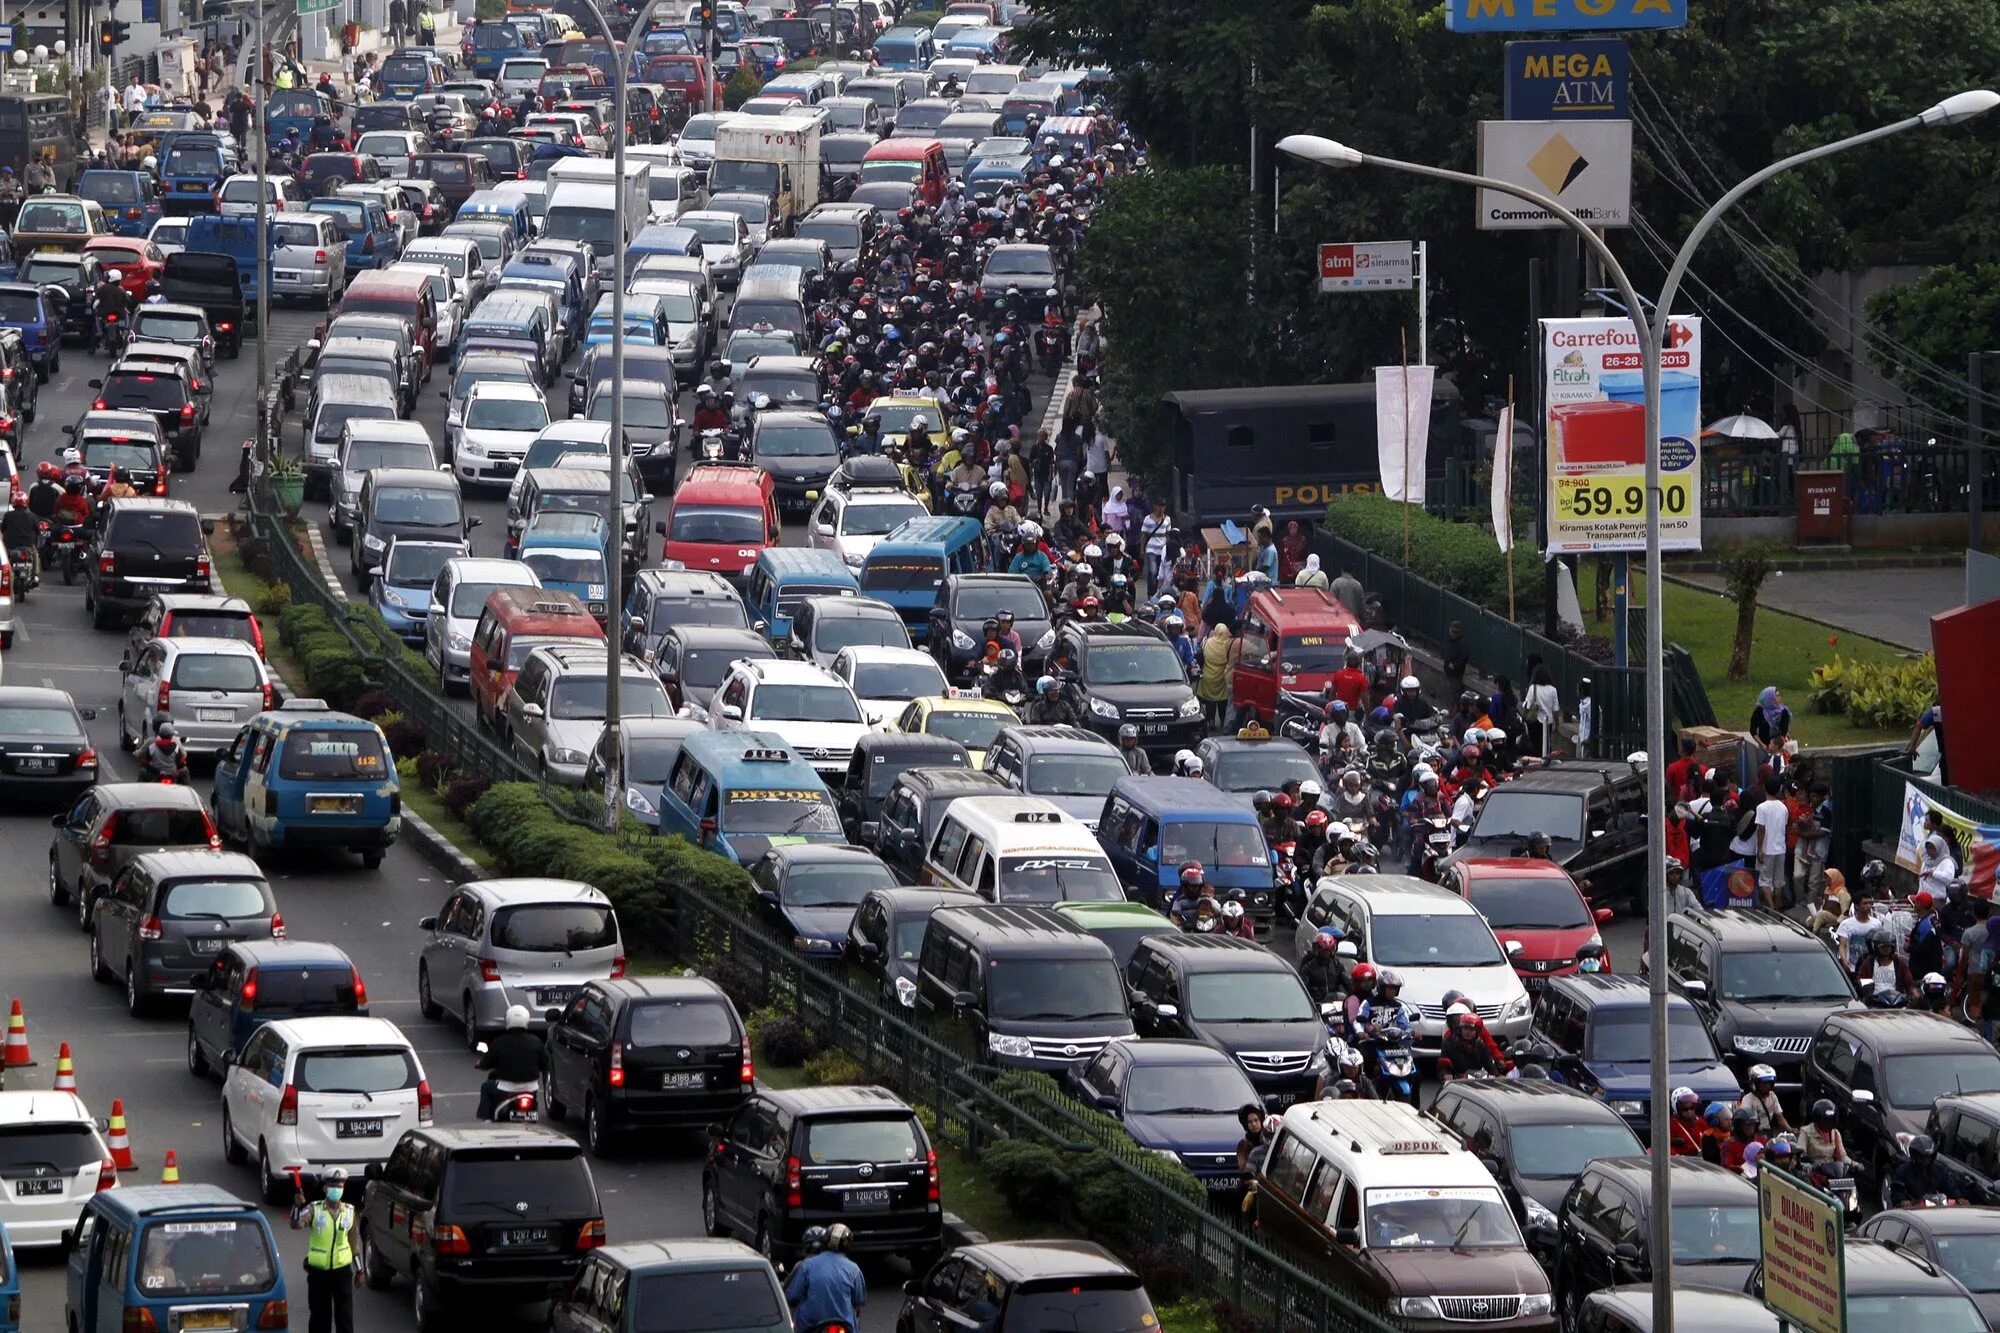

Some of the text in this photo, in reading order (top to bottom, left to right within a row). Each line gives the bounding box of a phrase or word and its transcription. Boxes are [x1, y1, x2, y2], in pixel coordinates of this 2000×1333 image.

[1524, 53, 1613, 78] MEGA
[1553, 80, 1614, 104] ATM
[1325, 255, 1409, 268] atm sinarmas
[1552, 328, 1639, 347] Carrefou
[1605, 355, 1686, 366] 26-28 2013
[1553, 368, 1590, 382] Fitrah
[1573, 485, 1685, 516] 59.90
[1559, 524, 1593, 532] Kiramas
[1586, 532, 1636, 540] Transparant
[358, 756, 376, 765] 112
[731, 790, 822, 800] DEPOK
[1014, 860, 1102, 872] AXEL
[1729, 898, 1752, 907] Mobil
[664, 1072, 670, 1083] B
[340, 1122, 344, 1132] B
[1395, 1142, 1439, 1150] DEPOK
[844, 1192, 850, 1201] B
[874, 1190, 888, 1200] EFS
[1782, 1196, 1814, 1232] DILARANG
[146, 1276, 164, 1288] 02
